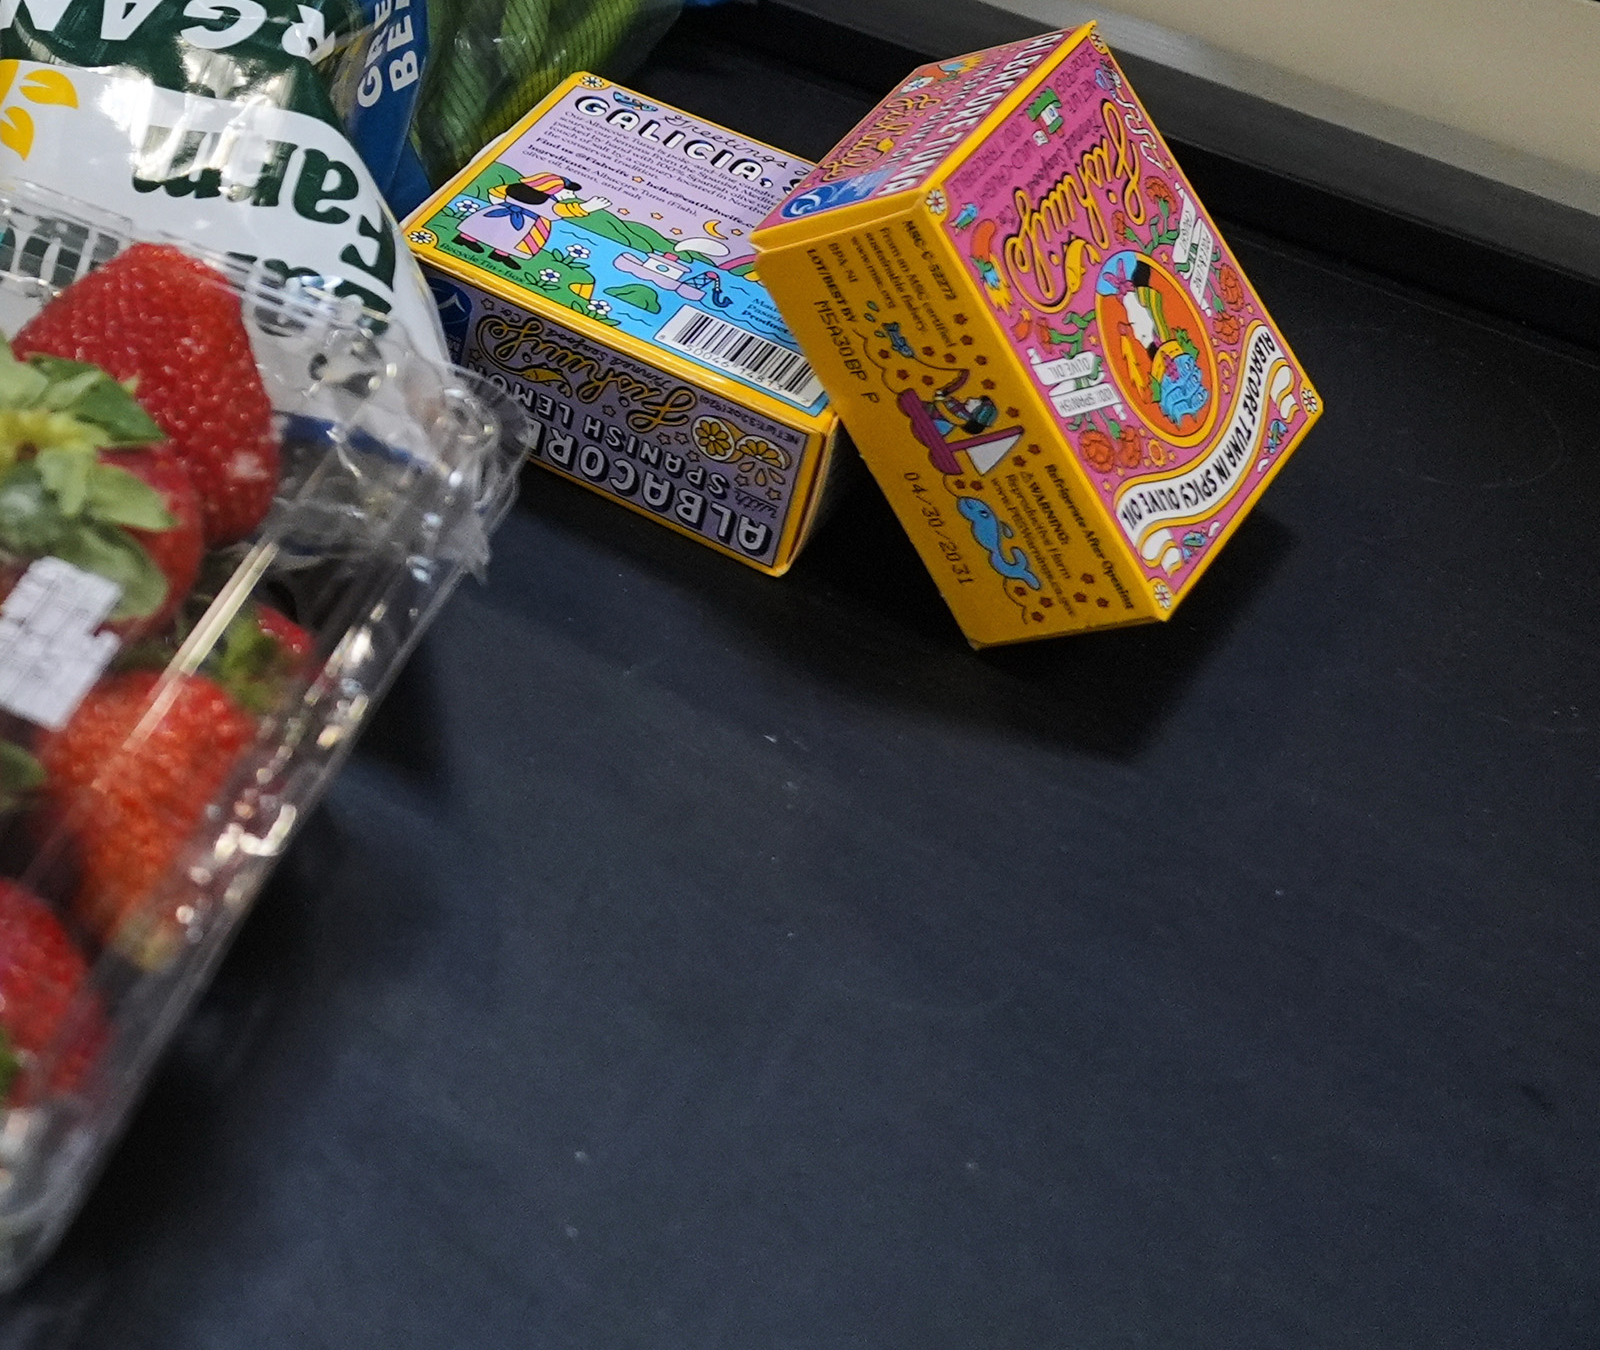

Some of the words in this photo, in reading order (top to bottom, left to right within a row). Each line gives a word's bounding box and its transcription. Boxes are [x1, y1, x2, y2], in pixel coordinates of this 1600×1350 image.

[940, 34, 1064, 134] ALBACORE
[535, 136, 557, 150] Find
[558, 146, 576, 158] us
[574, 152, 632, 180] @Fishwife
[544, 130, 563, 143] the
[563, 138, 609, 161] conservas
[609, 156, 660, 180] tradition.
[548, 124, 580, 142] touch
[580, 137, 593, 148] of
[592, 142, 610, 154] salt
[609, 150, 623, 161] by
[631, 159, 672, 181] cannery
[672, 175, 712, 195] located
[711, 190, 723, 200] in
[552, 119, 582, 136] packed
[581, 131, 598, 143] by
[599, 138, 627, 154] hand
[626, 149, 654, 165] with
[653, 160, 686, 178] 100%
[686, 173, 728, 195] Spanish
[728, 189, 756, 205] olive
[755, 200, 771, 211] oil
[558, 115, 589, 131] source
[588, 127, 609, 140] our
[610, 136, 651, 157] lemons
[649, 152, 677, 168] from
[676, 163, 696, 175] the
[695, 171, 739, 193] Spanish
[563, 109, 584, 124] Our
[586, 118, 630, 142] Albacore
[630, 136, 657, 153] Tuna
[665, 152, 738, 186] pole-and-line
[736, 180, 773, 201] caught
[574, 95, 774, 190] GALICIA,
[661, 113, 788, 169] Greetings
[820, 93, 942, 183] Fishwife
[876, 131, 966, 197] TUNA
[521, 148, 544, 162] olive
[544, 157, 563, 170] oil,
[563, 165, 601, 185] lemon,
[600, 180, 624, 194] and
[624, 189, 643, 201] salt
[526, 143, 592, 174] Ingredients:
[591, 169, 635, 192] Albacore
[636, 186, 666, 204] Tuna
[665, 198, 700, 218] (Fish),
[1003, 98, 1146, 313] Fishwife
[806, 248, 846, 305] LOT/BEST
[842, 306, 858, 323] BY
[851, 236, 895, 309] www.msc.org
[500, 306, 521, 323] Co.
[542, 324, 608, 364] Seafood
[475, 315, 698, 432] Fishwife
[610, 357, 672, 391] Tinned
[683, 344, 731, 370] 50046
[738, 364, 785, 391] 14813
[861, 391, 880, 403] P
[1242, 330, 1276, 416] ALBACORE
[605, 425, 731, 496] SPANISH
[1217, 462, 1233, 479] IN
[1227, 420, 1255, 463] TUNA
[733, 484, 777, 519] with
[1030, 483, 1069, 545] WARNING:
[1121, 495, 1141, 530] OIL
[1141, 492, 1181, 512] OLIVE
[1182, 475, 1218, 505] SPICY
[903, 471, 974, 584] 04/30/2031
[1006, 473, 1050, 546] Reproductive
[1051, 546, 1071, 580] Harm
[1045, 463, 1087, 529] Refrigerate
[1084, 529, 1105, 558] After
[1102, 559, 1135, 610] Opening
